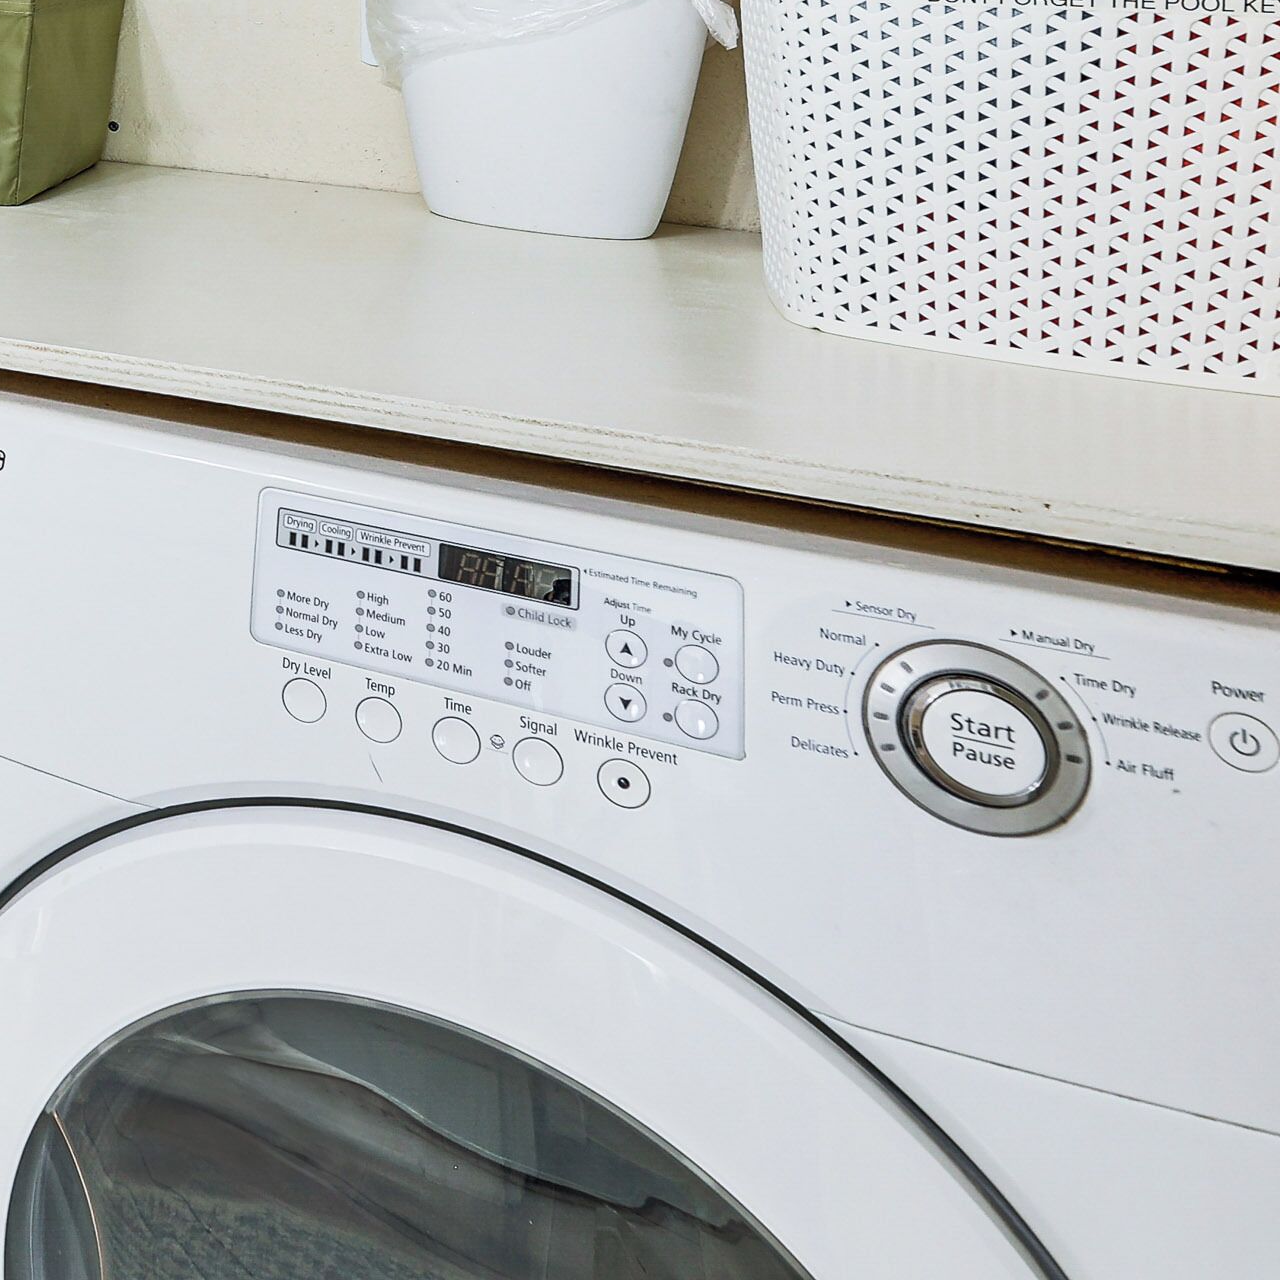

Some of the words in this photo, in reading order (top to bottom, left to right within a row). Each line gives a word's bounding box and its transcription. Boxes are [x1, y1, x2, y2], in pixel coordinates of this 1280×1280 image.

[287, 516, 314, 532] Drying
[321, 523, 351, 538] Cooling
[360, 531, 392, 545] Wrinkle
[394, 538, 425, 553] Prevent
[589, 568, 629, 583] Estimated
[631, 576, 650, 588] Time
[652, 581, 698, 599] Remaining
[287, 591, 311, 605] More
[313, 596, 329, 611] Dry
[367, 592, 389, 606] High
[439, 591, 452, 603] 60
[603, 597, 630, 610] Adjust
[632, 602, 652, 613] Time
[285, 607, 320, 623] Normal
[322, 615, 338, 630] Dry
[366, 609, 406, 625] Medium
[438, 607, 452, 619] 50
[517, 607, 545, 623] Child
[547, 614, 572, 628] Lock
[620, 614, 636, 627] Up
[856, 600, 894, 617] Sensor
[897, 608, 917, 623] Dry
[285, 624, 304, 636] Less
[306, 629, 322, 643] Dry
[365, 626, 386, 639] Low
[437, 625, 451, 636] 40
[671, 624, 689, 640] My
[691, 629, 722, 645] Cycle
[819, 627, 866, 647] Normal
[437, 643, 450, 654] 30
[516, 642, 552, 660] Louder
[1022, 629, 1070, 648] Manual
[1073, 638, 1096, 654] Dry
[364, 643, 389, 657] Extra
[392, 648, 413, 663] Low
[282, 656, 302, 675] Dry
[303, 662, 332, 681] Level
[436, 659, 450, 671] 20
[452, 663, 473, 677] Min
[515, 660, 547, 677] Softer
[773, 651, 812, 671] Heavy
[815, 659, 845, 678] Duty
[515, 678, 532, 692] Off
[610, 668, 643, 685] Down
[1073, 673, 1108, 690] Time
[1112, 679, 1137, 698] Dry
[365, 677, 396, 698] Temp
[671, 681, 698, 698] Rack
[702, 689, 722, 705] Dry
[1211, 680, 1266, 703] Power
[444, 697, 472, 715] Time
[771, 690, 803, 708] Perm
[806, 698, 839, 715] Press
[519, 714, 558, 738] Signal
[951, 712, 1016, 743] Start
[1102, 712, 1150, 732] Wrinkle
[1153, 722, 1202, 742] Release
[574, 728, 624, 752] Wrinkle
[627, 741, 678, 766] Prevent
[791, 735, 849, 759] Delicates
[952, 742, 1016, 770] Pause
[1116, 759, 1137, 773] Air
[1141, 763, 1175, 781] Fluff
